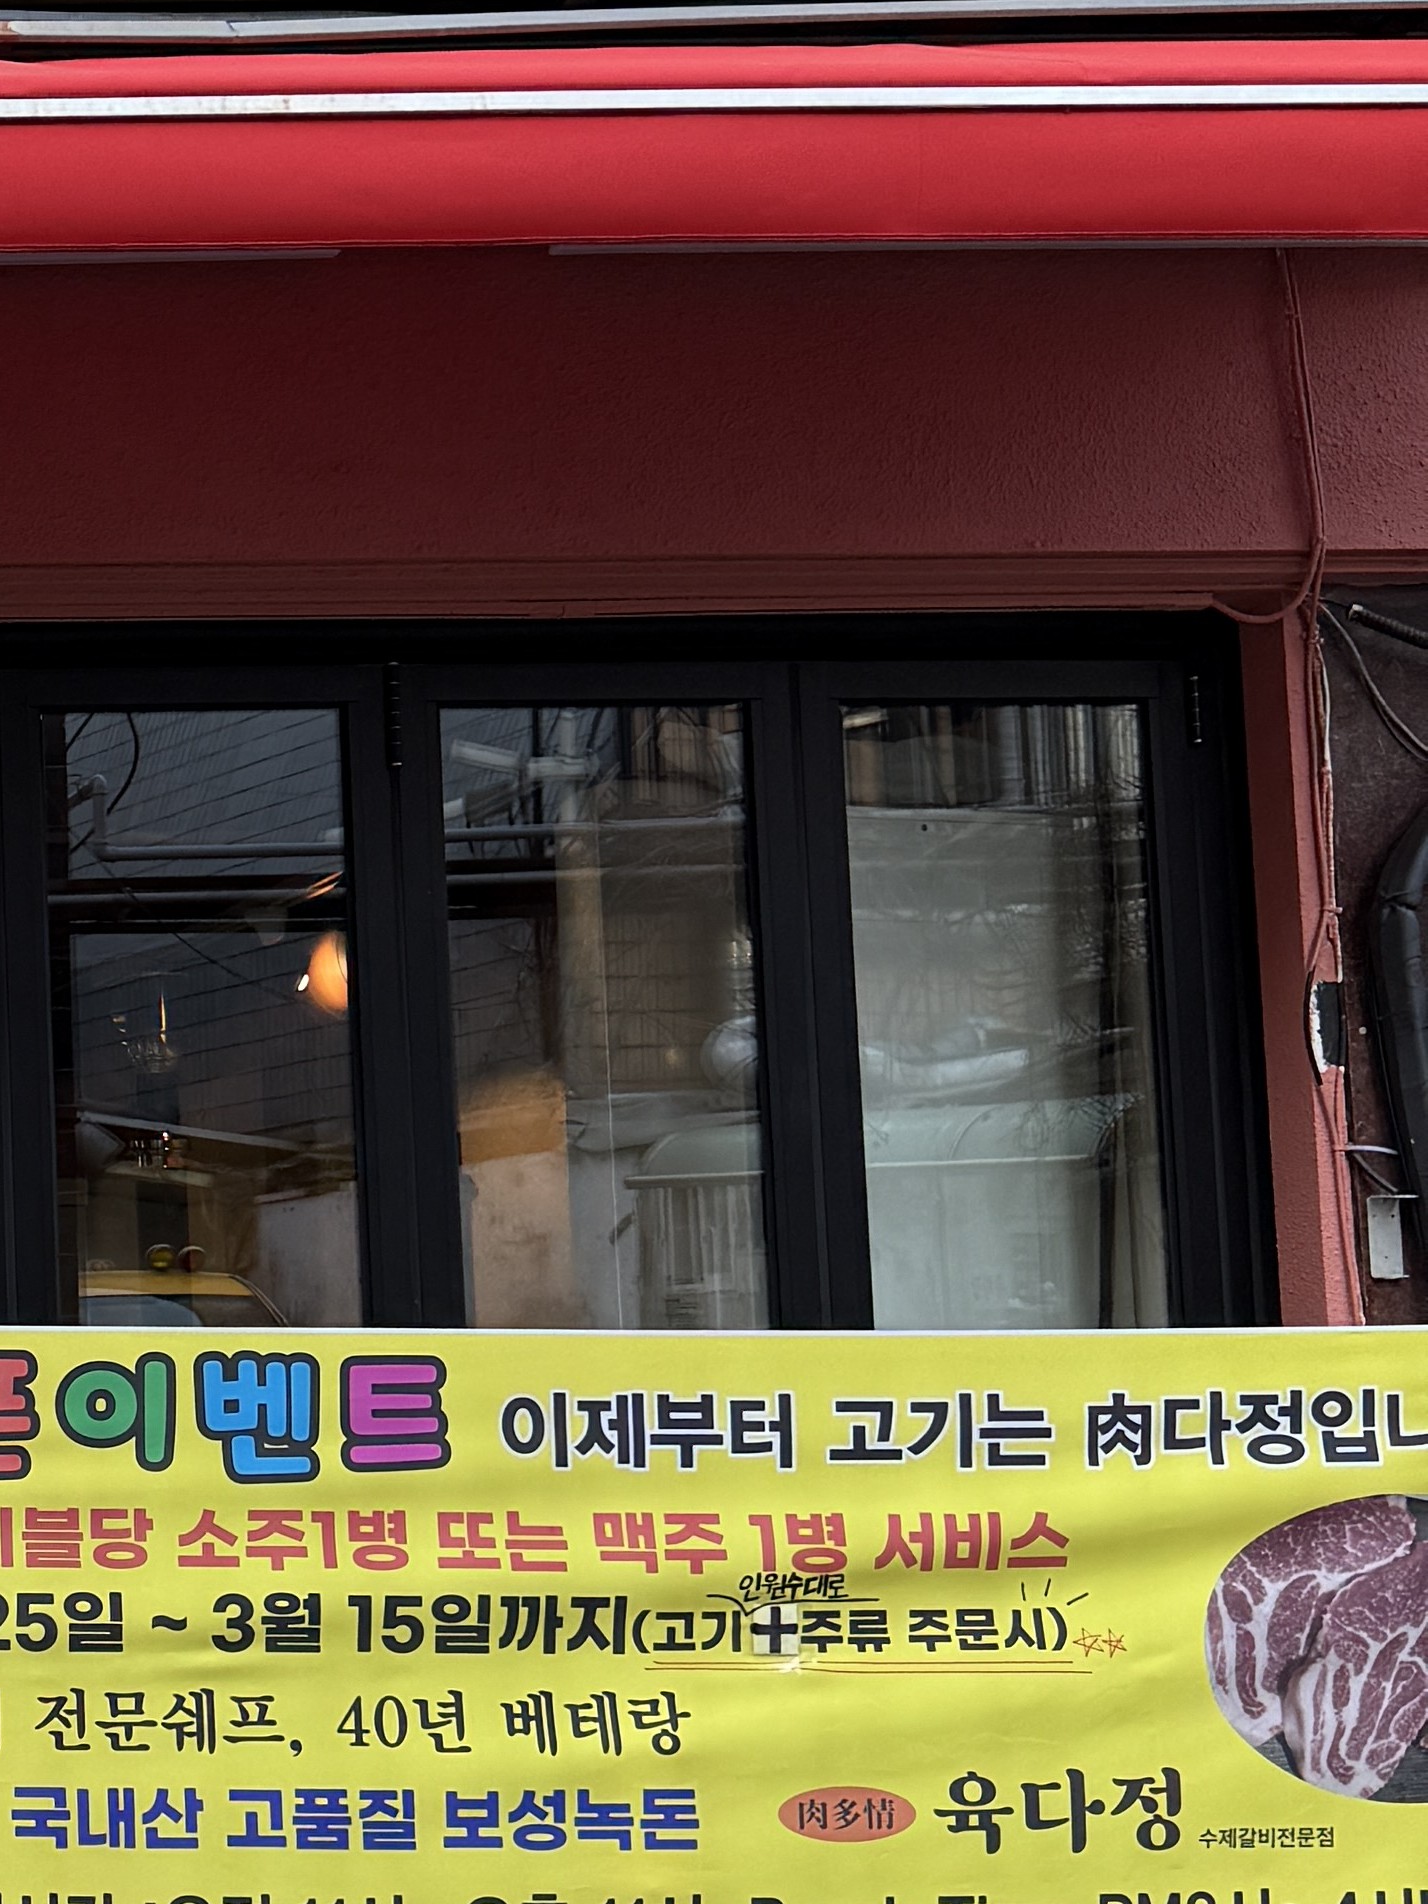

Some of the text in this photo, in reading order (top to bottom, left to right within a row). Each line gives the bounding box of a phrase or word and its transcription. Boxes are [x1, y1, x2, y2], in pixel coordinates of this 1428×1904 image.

[502, 1393, 792, 1468] 이제부터
[830, 1394, 1049, 1467] 고기는
[178, 1510, 408, 1571] 소주1병
[437, 1511, 566, 1572] 또는
[593, 1513, 726, 1575] 맥주
[749, 1514, 846, 1574] 1병
[876, 1513, 1065, 1571] 서비스
[739, 1573, 850, 1602] 인원수대로
[152, 1615, 187, 1631] ~
[212, 1593, 321, 1652] 3월
[907, 1606, 1069, 1653] 주문시)
[35, 1688, 302, 1756] 전문쉐프,
[337, 1690, 471, 1752] 40년
[500, 1691, 691, 1756] 베테랑
[12, 1789, 697, 1850] 국내산 고품질 보성녹돈
[799, 1799, 894, 1829] 肉多情
[934, 1768, 1181, 1854] 육다정
[1199, 1827, 1333, 1848] 수제갈비전문점
